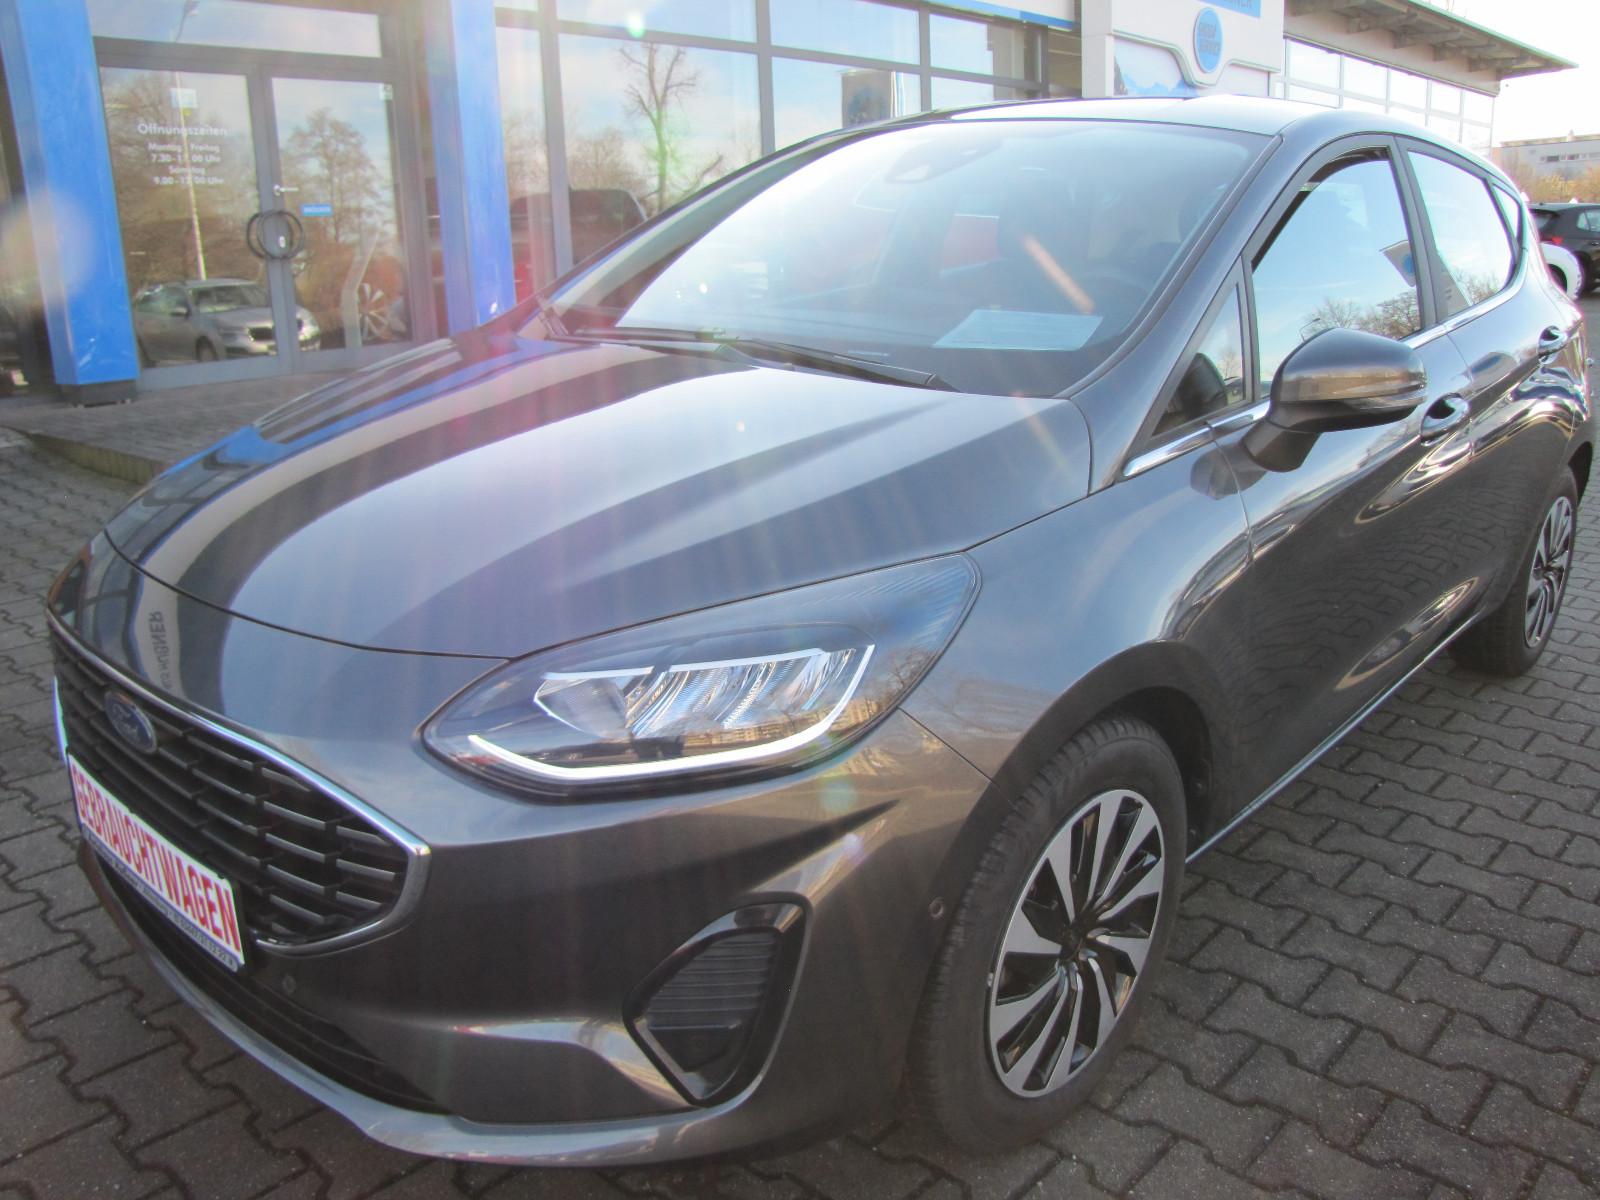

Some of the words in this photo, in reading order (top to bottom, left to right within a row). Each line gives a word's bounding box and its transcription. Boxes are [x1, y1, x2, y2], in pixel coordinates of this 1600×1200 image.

[137, 119, 228, 137] Öffnungszeiten
[148, 142, 182, 153] Montag
[190, 143, 220, 153] Freitag
[205, 153, 221, 163] Uhr
[168, 165, 206, 176] Samstag
[207, 176, 225, 185] Uhr
[71, 761, 241, 952] GEBRAUCHTWAGEN
